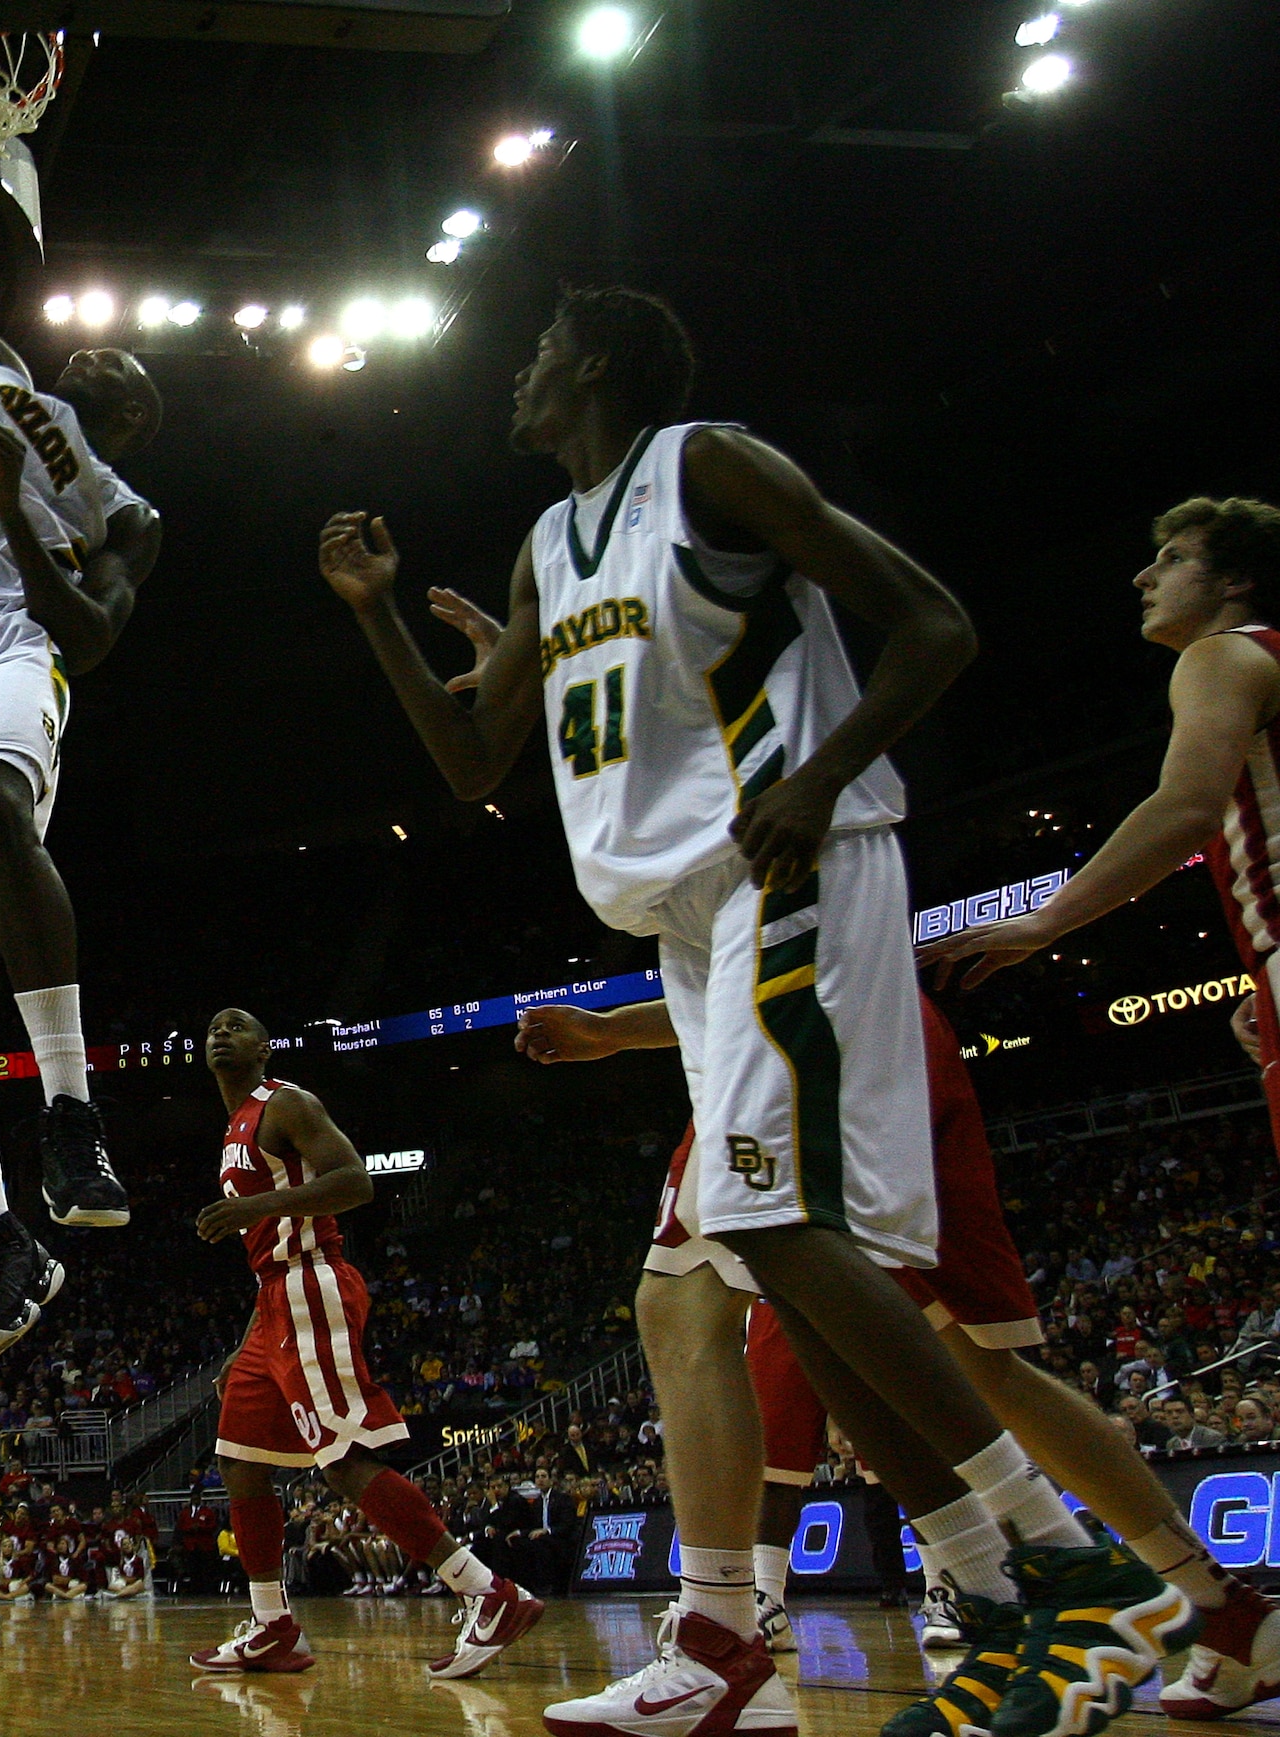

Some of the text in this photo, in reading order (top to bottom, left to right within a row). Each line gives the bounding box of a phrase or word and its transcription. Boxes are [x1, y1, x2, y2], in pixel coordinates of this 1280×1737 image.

[540, 597, 653, 682] BAYLOR
[560, 664, 630, 780] 41
[514, 986, 567, 1005] Northern
[572, 980, 607, 994] Color
[1151, 974, 1257, 1013] TOYOTA
[332, 1001, 480, 1037] Marshall 65 8:00
[333, 1018, 473, 1052] Houston 62 2
[120, 1039, 194, 1056] P R S B
[269, 1038, 290, 1051] CAA
[1002, 1036, 1031, 1050] Center
[726, 1134, 777, 1192] BU
[290, 1400, 322, 1449] OU
